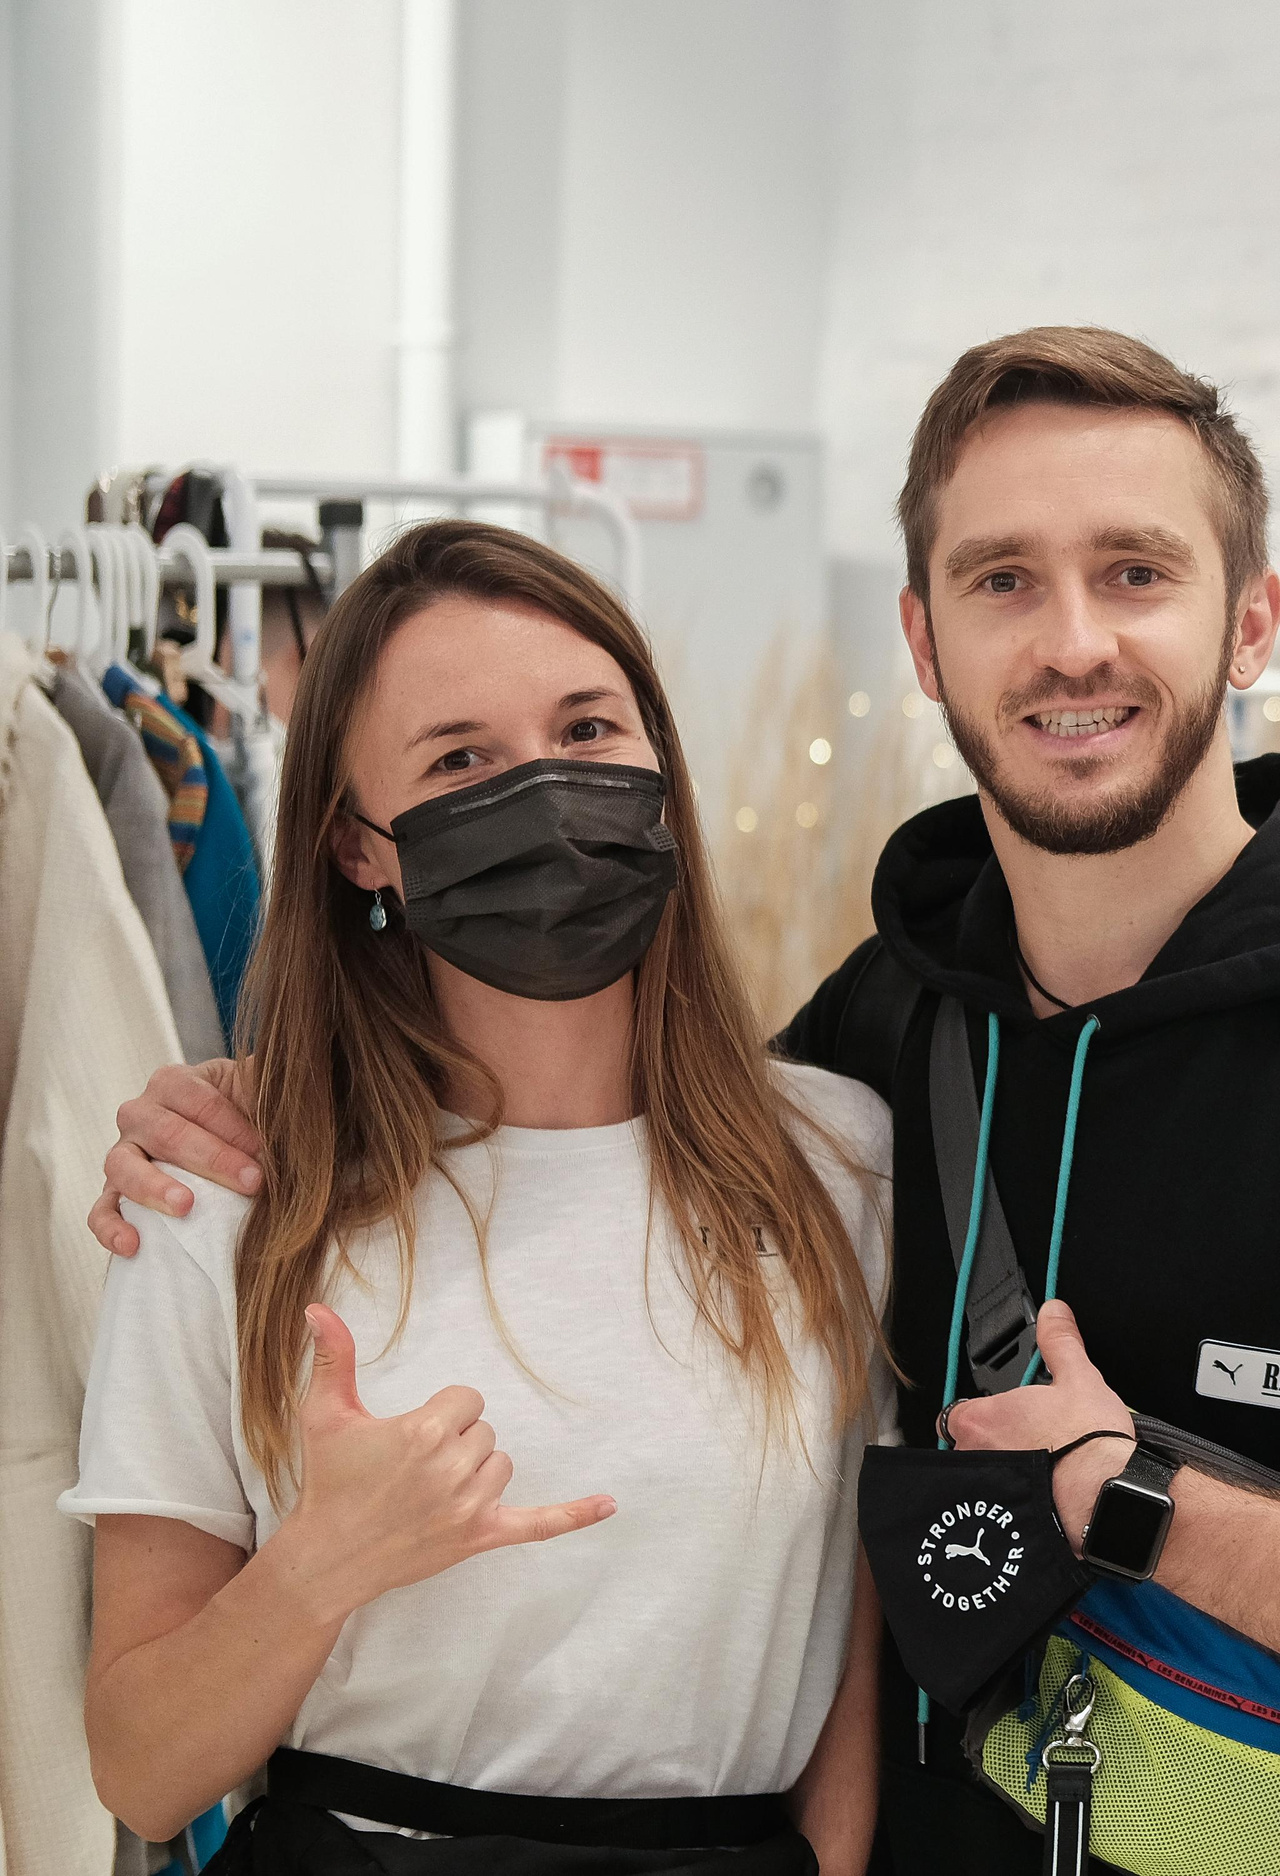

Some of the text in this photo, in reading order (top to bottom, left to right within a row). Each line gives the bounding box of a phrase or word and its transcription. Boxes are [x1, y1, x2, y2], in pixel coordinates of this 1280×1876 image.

[917, 1500, 1014, 1565] STRONGER
[931, 1546, 1025, 1611] TOGETHER
[1157, 1664, 1173, 1677] LES
[1174, 1673, 1228, 1701] BENJAMINS
[1251, 1703, 1268, 1715] LES
